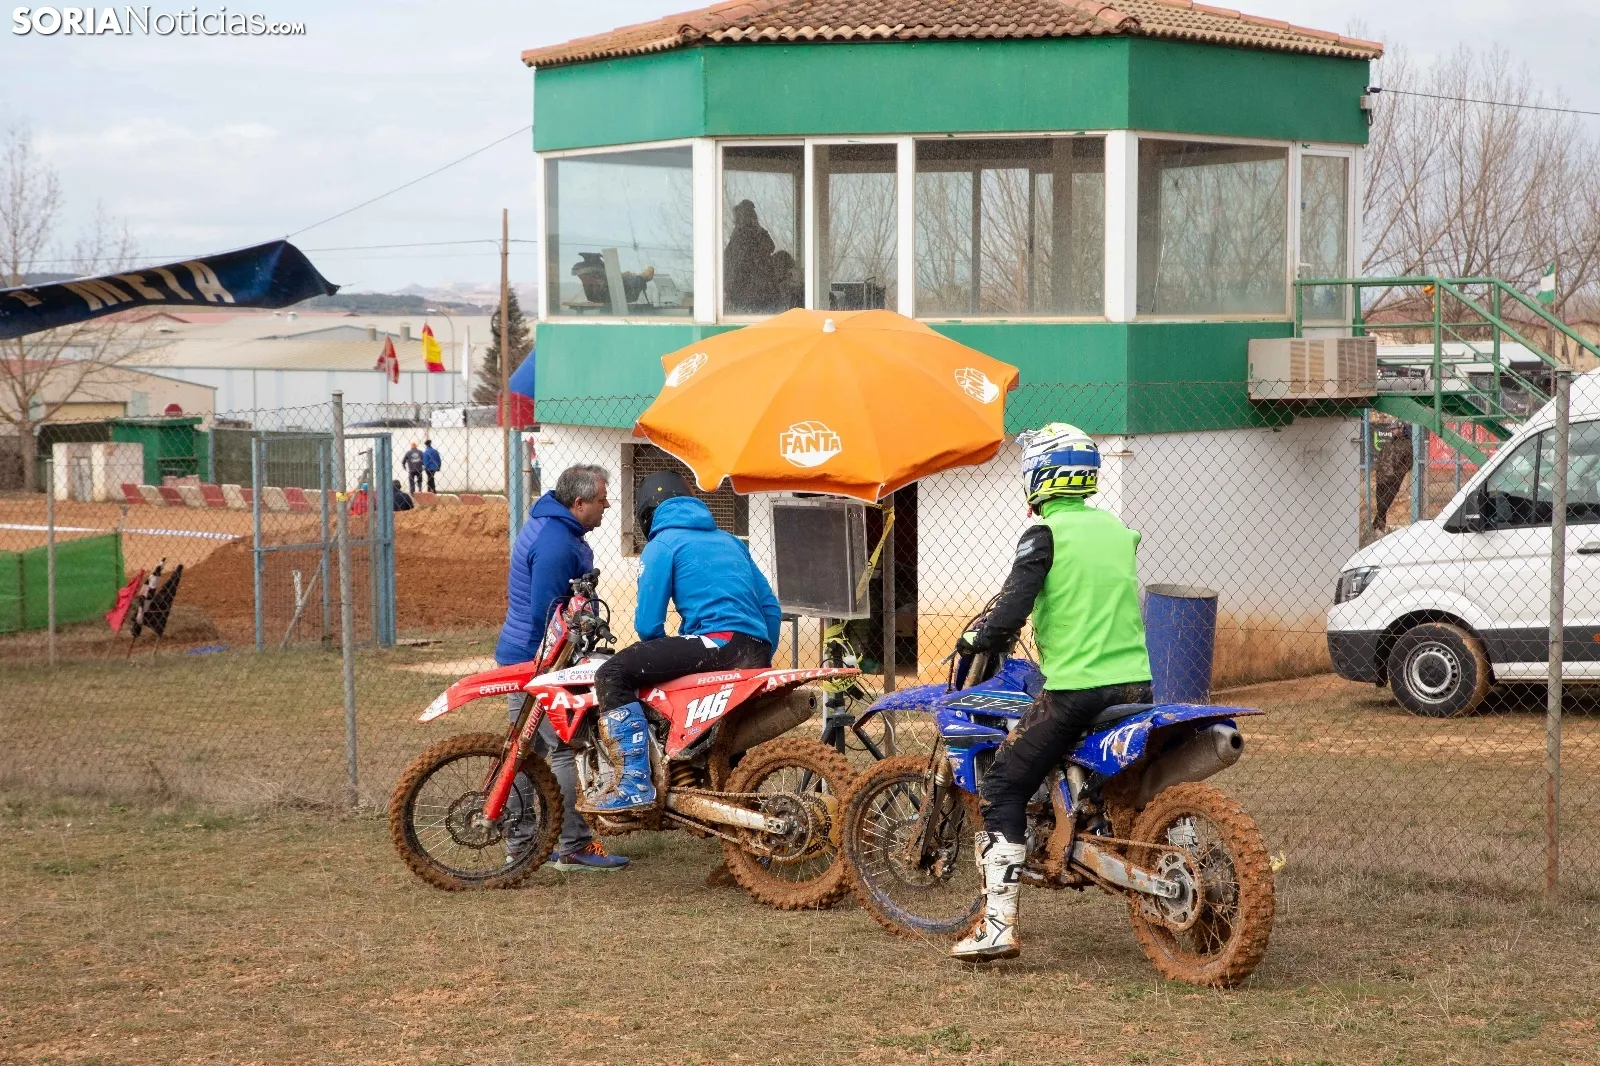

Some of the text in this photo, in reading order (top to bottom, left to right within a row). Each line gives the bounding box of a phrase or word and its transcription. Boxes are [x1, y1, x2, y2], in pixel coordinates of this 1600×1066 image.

[780, 431, 842, 456] FANTA
[697, 672, 742, 685] HONDA
[479, 683, 520, 695] CASTILLA
[684, 688, 733, 728] 146
